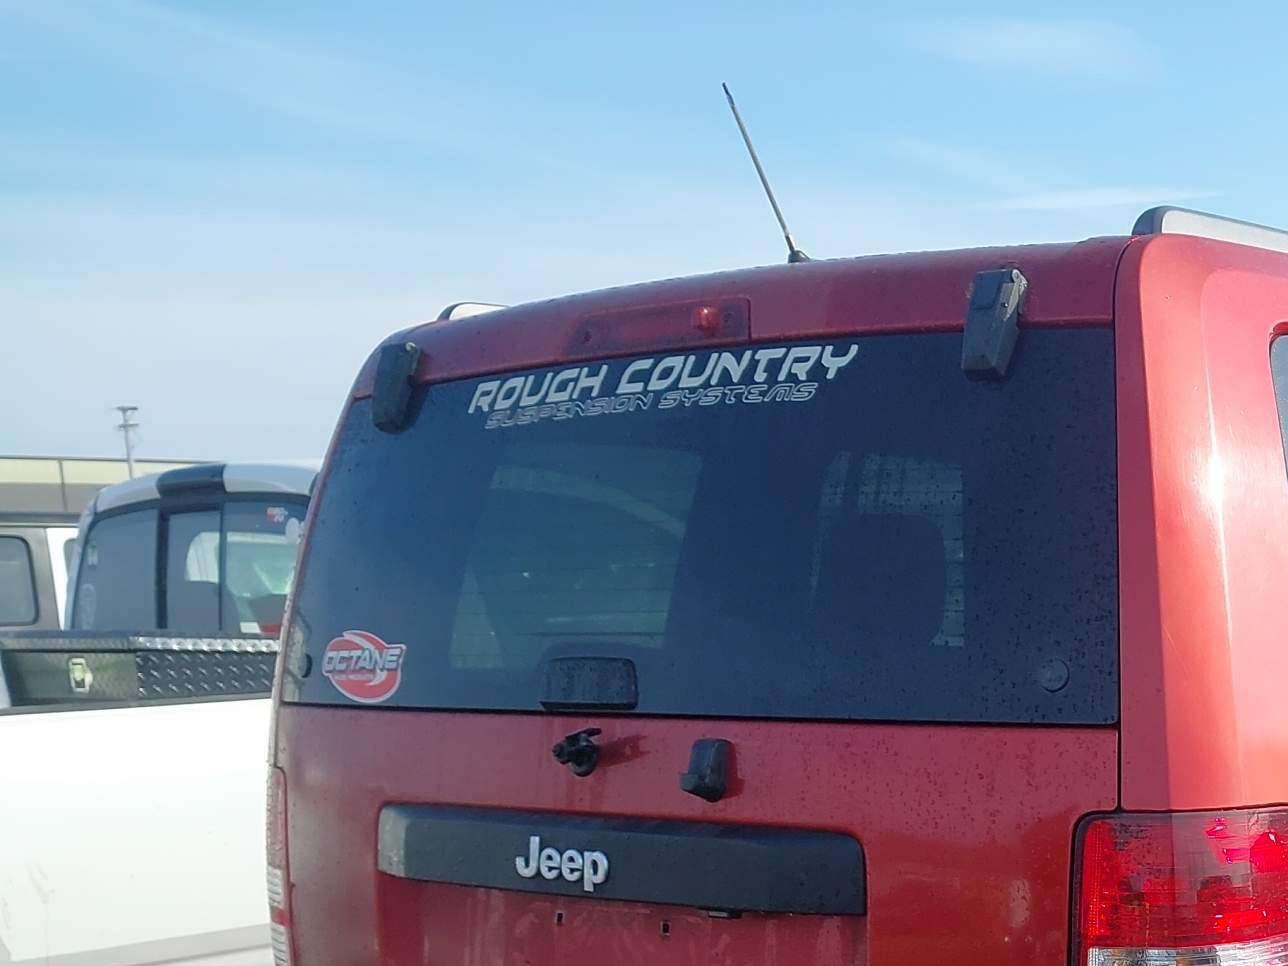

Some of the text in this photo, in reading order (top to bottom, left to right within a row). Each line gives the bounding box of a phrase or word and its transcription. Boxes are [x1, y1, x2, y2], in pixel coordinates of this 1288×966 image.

[468, 344, 859, 414] ROUGH COUNTRY
[485, 382, 818, 430] SUSPENSION SYSTEMS
[324, 648, 401, 672] OCTANE
[515, 835, 608, 892] Jeep
